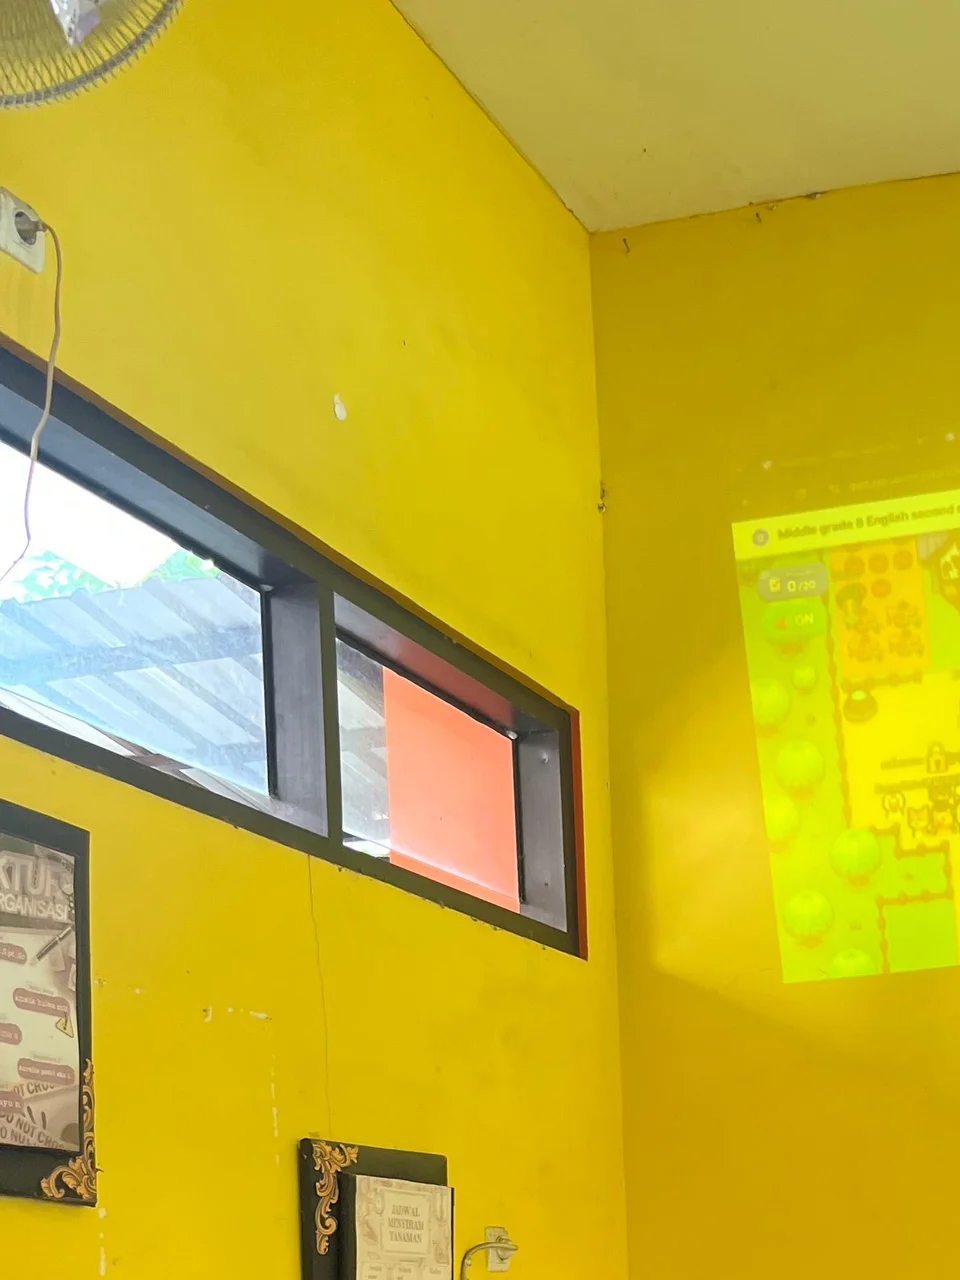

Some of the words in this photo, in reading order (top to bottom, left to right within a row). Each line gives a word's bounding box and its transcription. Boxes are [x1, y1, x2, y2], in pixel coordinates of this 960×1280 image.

[777, 526, 818, 540] Middle
[819, 520, 854, 537] grade
[866, 511, 910, 528] English
[911, 504, 955, 519] second
[795, 612, 815, 626] ON
[392, 1204, 420, 1217] JADWAL
[390, 1231, 422, 1243] TANAMAN
